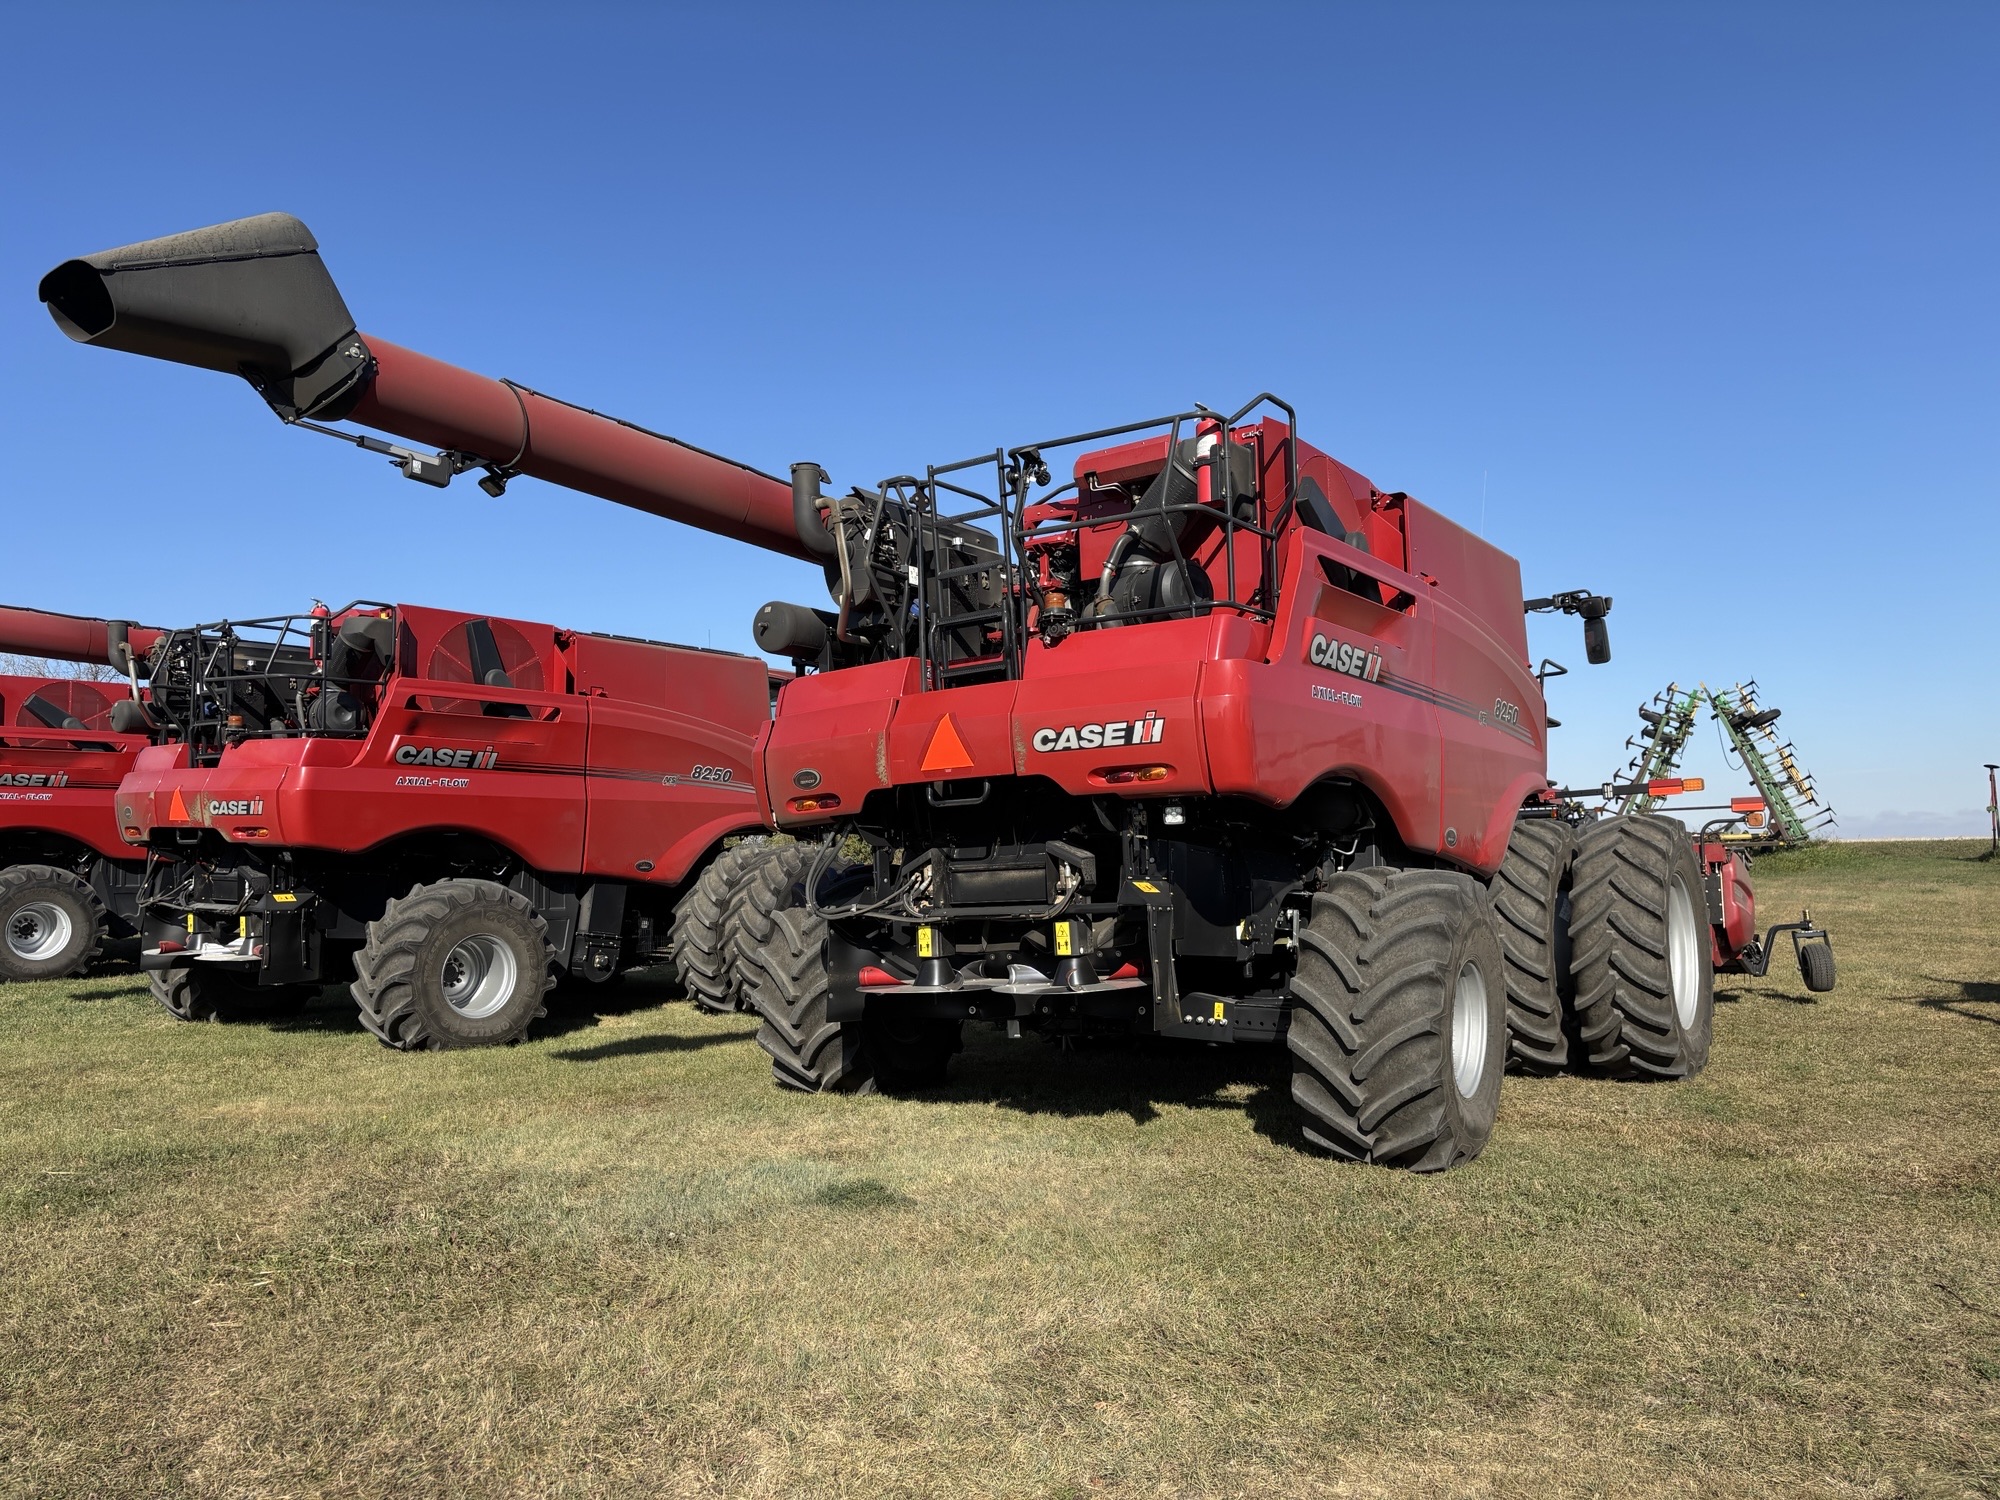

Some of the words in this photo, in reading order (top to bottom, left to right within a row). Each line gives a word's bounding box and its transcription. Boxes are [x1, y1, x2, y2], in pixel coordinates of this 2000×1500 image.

[1310, 633, 1366, 677] CASE
[1311, 684, 1362, 708] AXIAL-FLOW
[1494, 697, 1519, 726] 8250
[1032, 721, 1128, 753] CASE
[395, 745, 473, 768] CASE
[0, 773, 46, 787] ASE
[396, 776, 469, 788] AXIAL-FLOW
[691, 764, 733, 783] 8250
[0, 792, 53, 801] XIAL-FLOW
[210, 800, 248, 815] CASE
